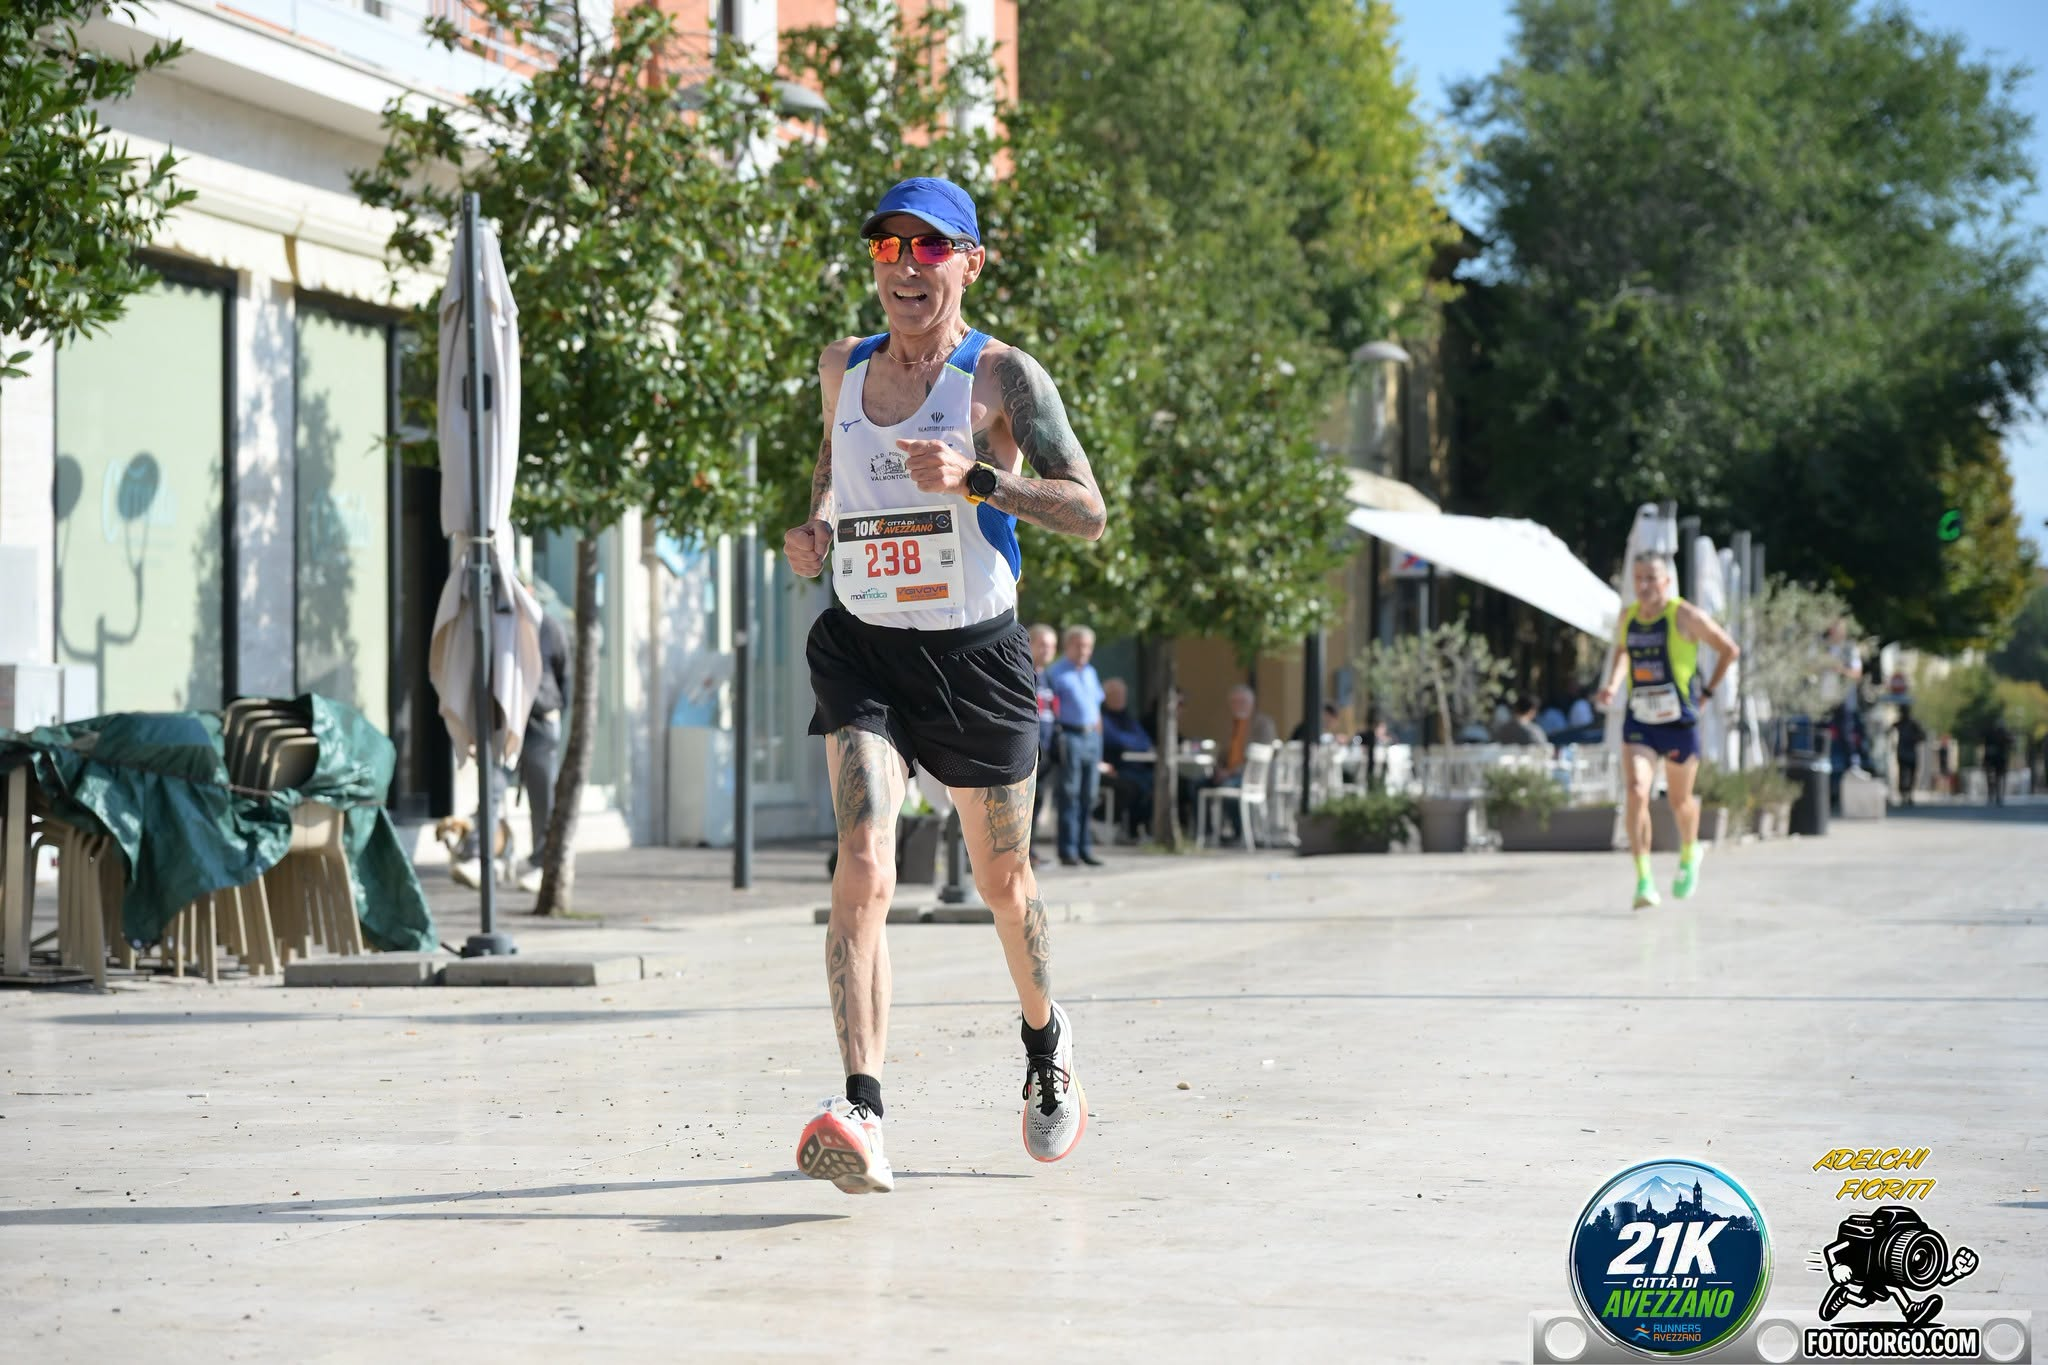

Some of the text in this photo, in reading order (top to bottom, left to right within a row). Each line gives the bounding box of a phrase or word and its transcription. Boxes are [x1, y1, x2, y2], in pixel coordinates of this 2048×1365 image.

[870, 473, 910, 481] VALMONTONE
[854, 519, 881, 537] 10K
[864, 539, 922, 578] 238
[904, 585, 949, 595] GIVOVA
